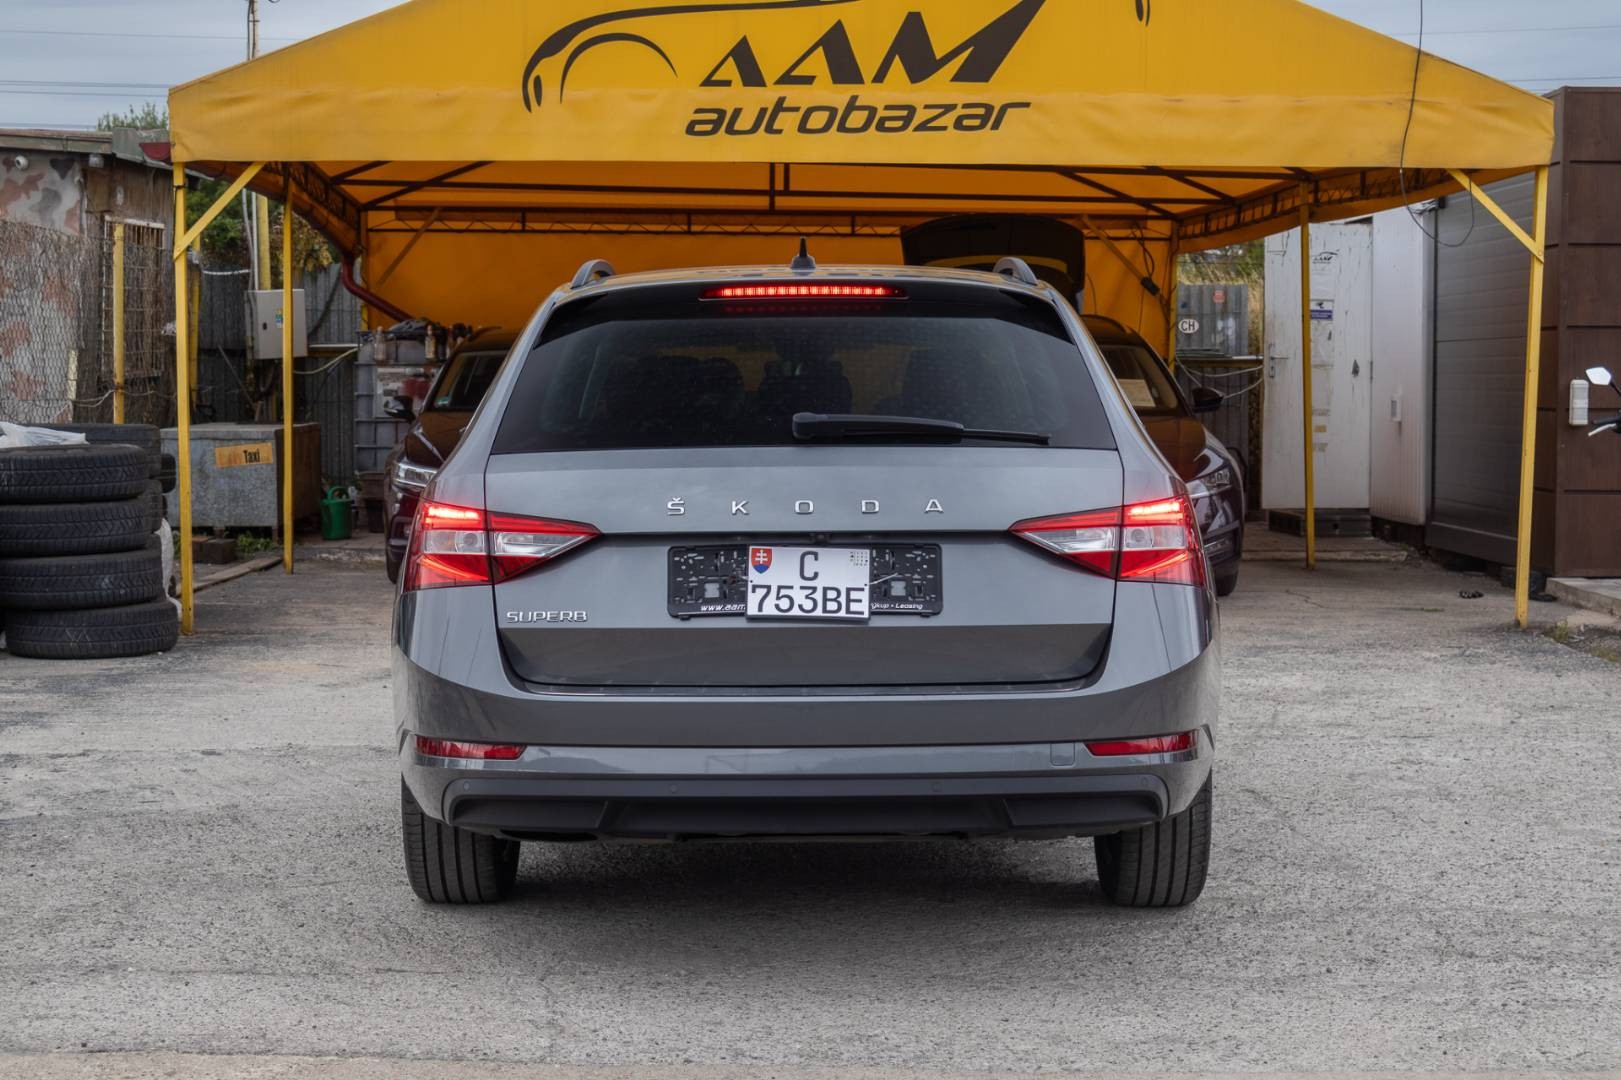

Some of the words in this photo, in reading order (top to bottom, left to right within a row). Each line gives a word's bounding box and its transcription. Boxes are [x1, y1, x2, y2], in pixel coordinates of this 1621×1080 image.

[698, 0, 1046, 87] AAM
[685, 95, 1032, 137] autobazar
[1181, 320, 1195, 331] CH
[242, 448, 260, 464] Taxi
[666, 497, 944, 516] ŠKODA
[799, 550, 819, 581] C
[751, 584, 865, 615] 753BE
[506, 610, 588, 624] SUPERB
